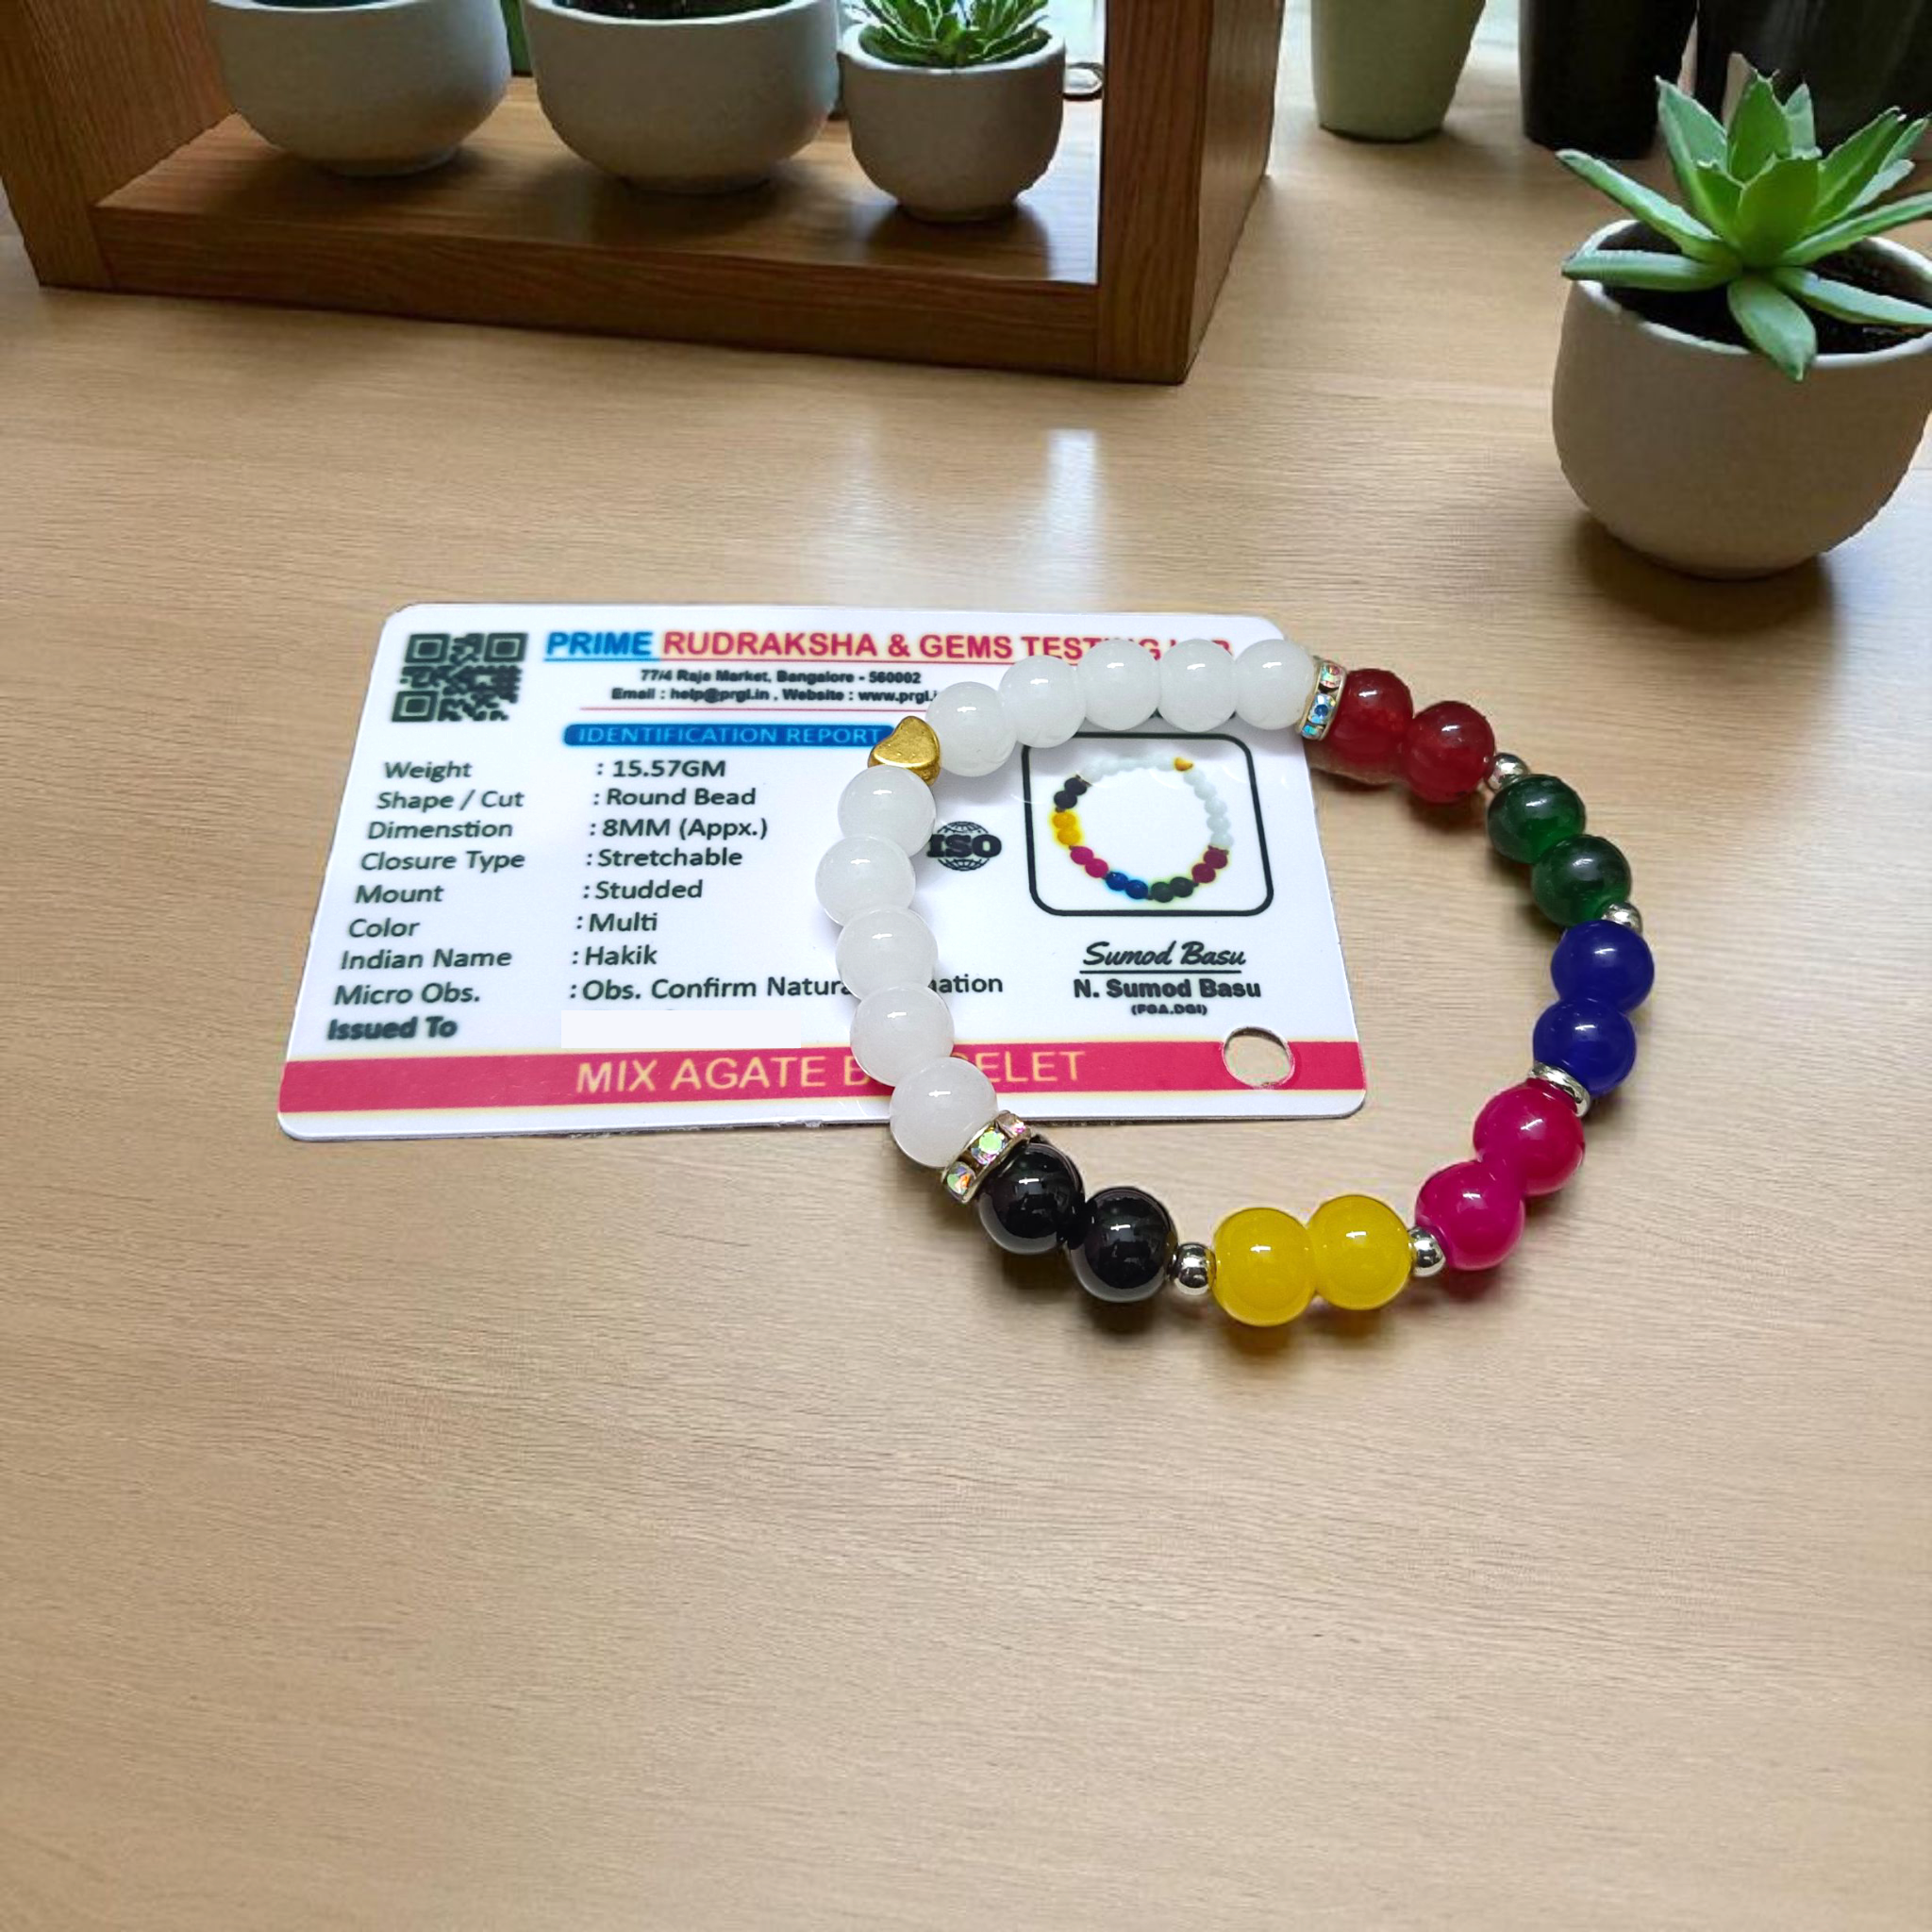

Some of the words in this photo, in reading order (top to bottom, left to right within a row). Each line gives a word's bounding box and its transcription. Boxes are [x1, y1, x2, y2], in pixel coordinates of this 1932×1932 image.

[545, 630, 655, 658] PRIME
[662, 631, 878, 658] RUDRAKSHA
[888, 634, 911, 658] &
[919, 635, 1013, 659] GEMS
[1021, 636, 1162, 661] TESTG
[641, 669, 673, 681] 77/4
[676, 669, 711, 684] Raja
[715, 670, 772, 683] Market,
[776, 670, 855, 686] Bangalore
[869, 671, 921, 684] 560002
[611, 688, 656, 699] Email
[782, 689, 844, 701] Website
[857, 689, 938, 706] www.prgl.i
[578, 726, 776, 744] IDENTIFICATION
[786, 728, 882, 743] REPORT
[386, 761, 472, 782] Weight
[613, 759, 725, 777] 15.57GM
[377, 791, 454, 812] Shape
[481, 791, 524, 808] Cut
[607, 788, 686, 805] Round
[694, 788, 756, 805] Bead
[368, 821, 512, 839] Dimenstion
[603, 819, 670, 837] 8MM
[679, 818, 767, 841] (Appx.)
[926, 834, 1002, 858] ISO
[361, 852, 457, 871] Closure
[466, 851, 525, 873] Type
[598, 847, 742, 867] Stretchable
[356, 885, 443, 903] Mount
[595, 879, 703, 899] Studded
[349, 918, 420, 938] Color
[590, 912, 658, 932] Multi
[341, 949, 424, 970] Indian
[433, 949, 511, 967] Name
[585, 944, 657, 965] Hakik
[1083, 941, 1176, 965] Sumod
[1180, 941, 1246, 965] Basu
[334, 985, 413, 1005] Micro
[421, 982, 479, 1003] Obs.
[583, 979, 641, 1000] Obs.
[652, 977, 757, 999] Confirm
[766, 975, 850, 997] Natura
[1074, 979, 1100, 998] N.
[1107, 978, 1191, 998] Sumod
[1199, 978, 1261, 998] Basu
[327, 1017, 418, 1041] Issued
[425, 1016, 458, 1038] To
[575, 1058, 658, 1094] MIX
[670, 1056, 827, 1091] AGATE
